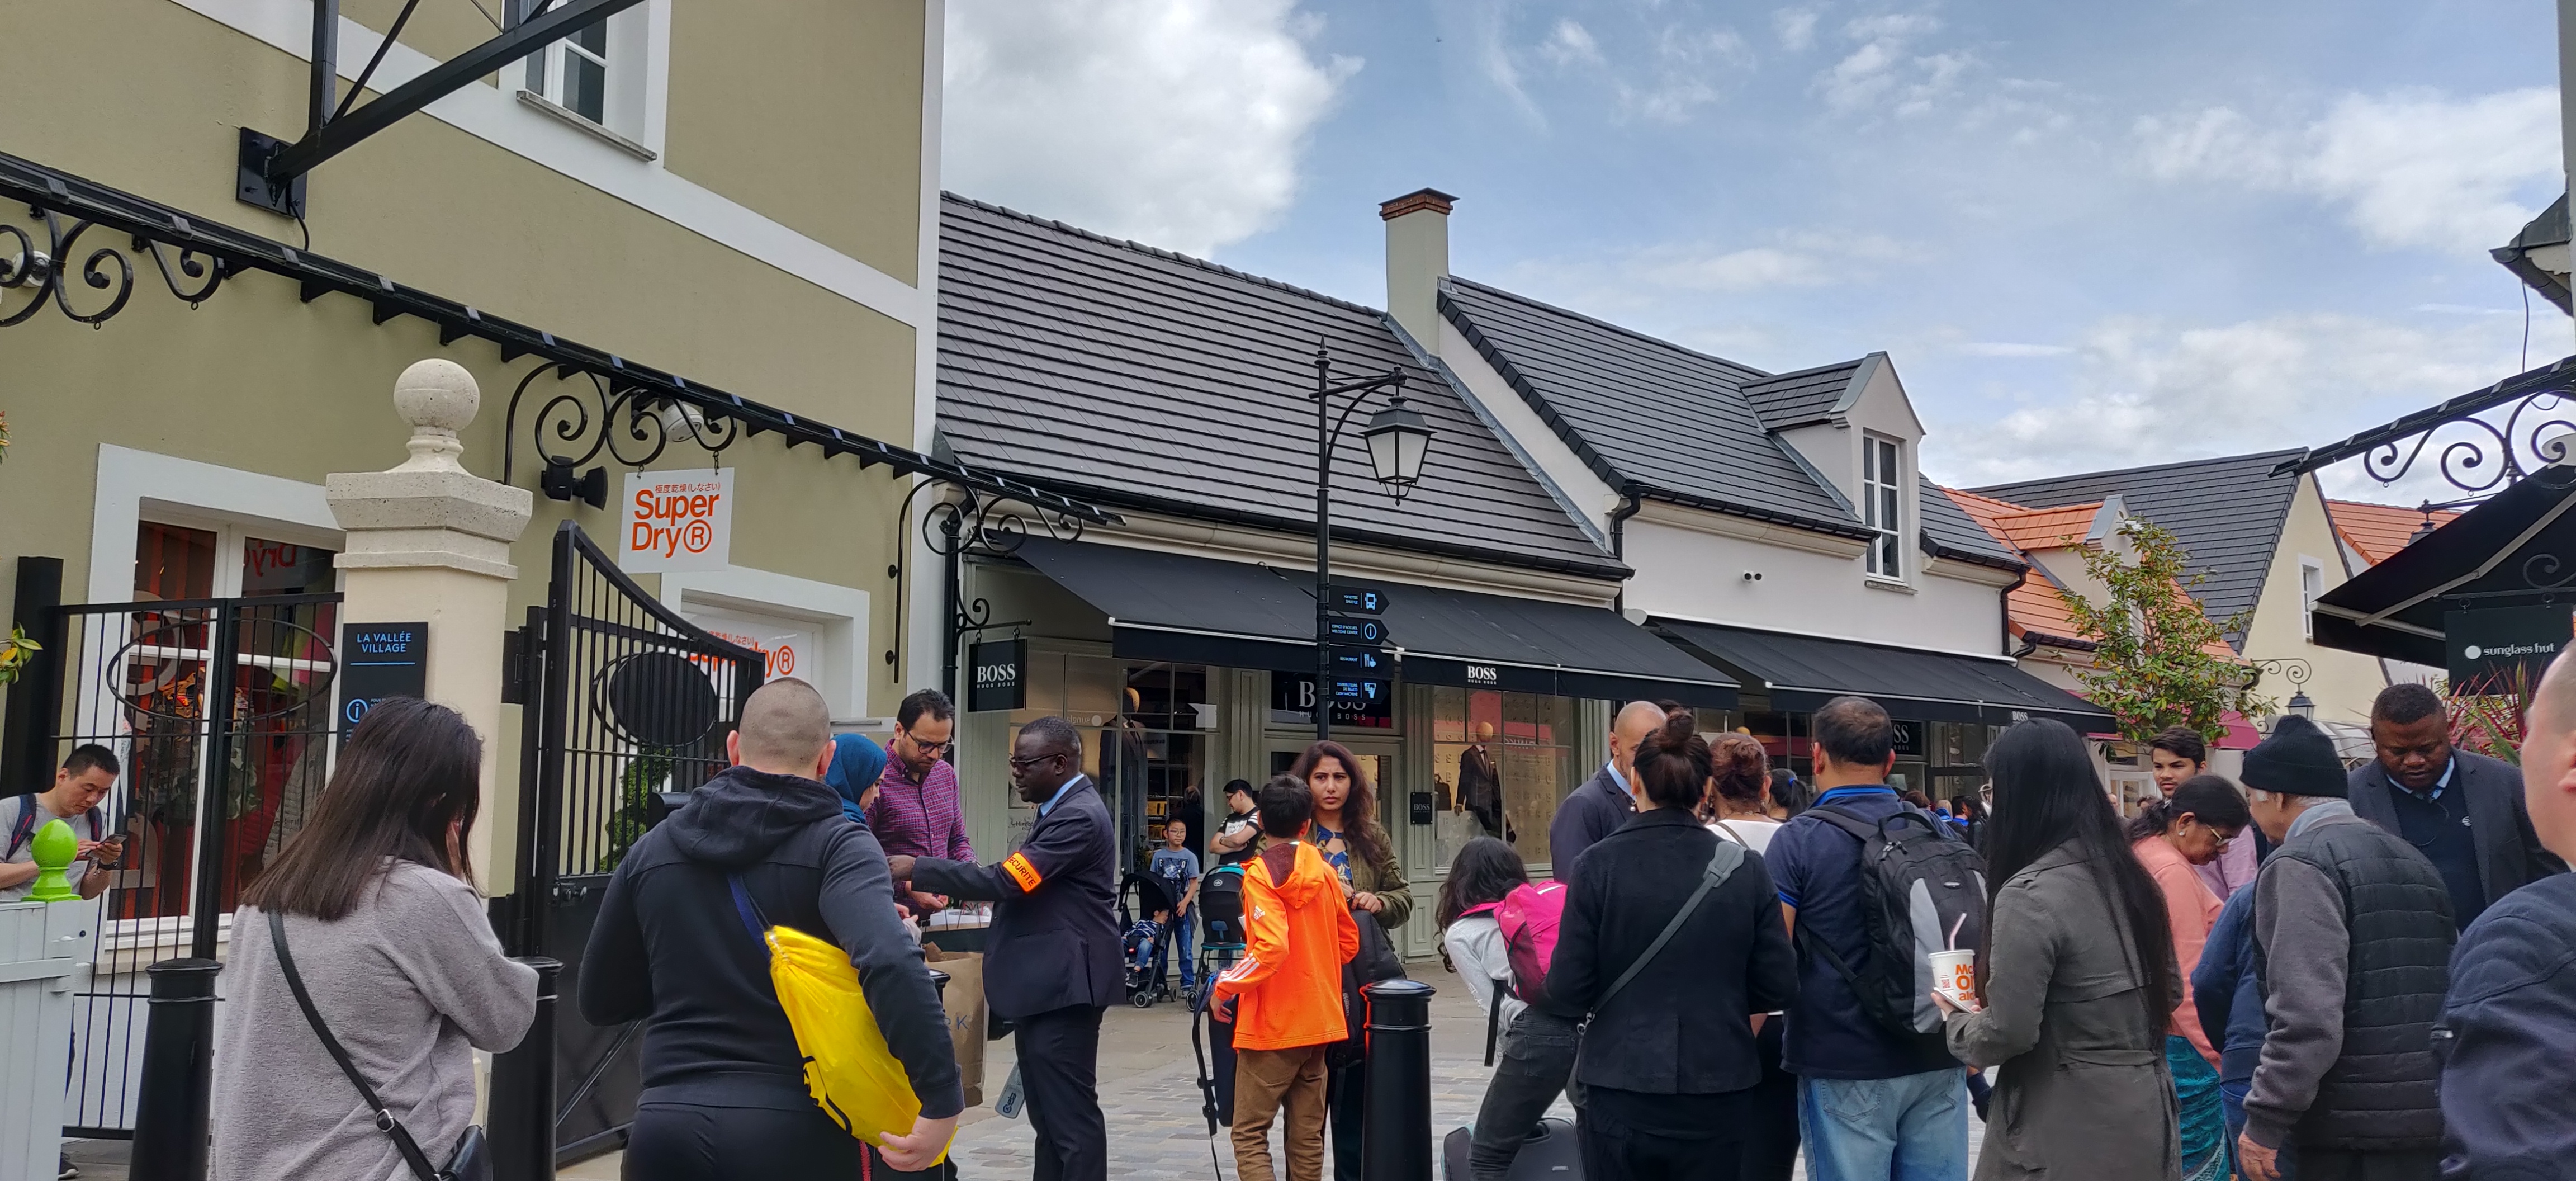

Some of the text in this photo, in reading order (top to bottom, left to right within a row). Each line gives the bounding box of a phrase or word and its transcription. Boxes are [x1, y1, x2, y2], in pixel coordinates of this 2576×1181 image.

[655, 482, 721, 494] 極度乾燥(しなさい)
[634, 489, 720, 526] Super
[357, 631, 411, 643] LA VALLÉE
[362, 643, 407, 653] VILLAGE
[2483, 643, 2556, 658] sunglass hut
[977, 663, 1016, 682] BOSS
[1467, 665, 1497, 680] BOSS
[2012, 711, 2029, 721] BOSS
